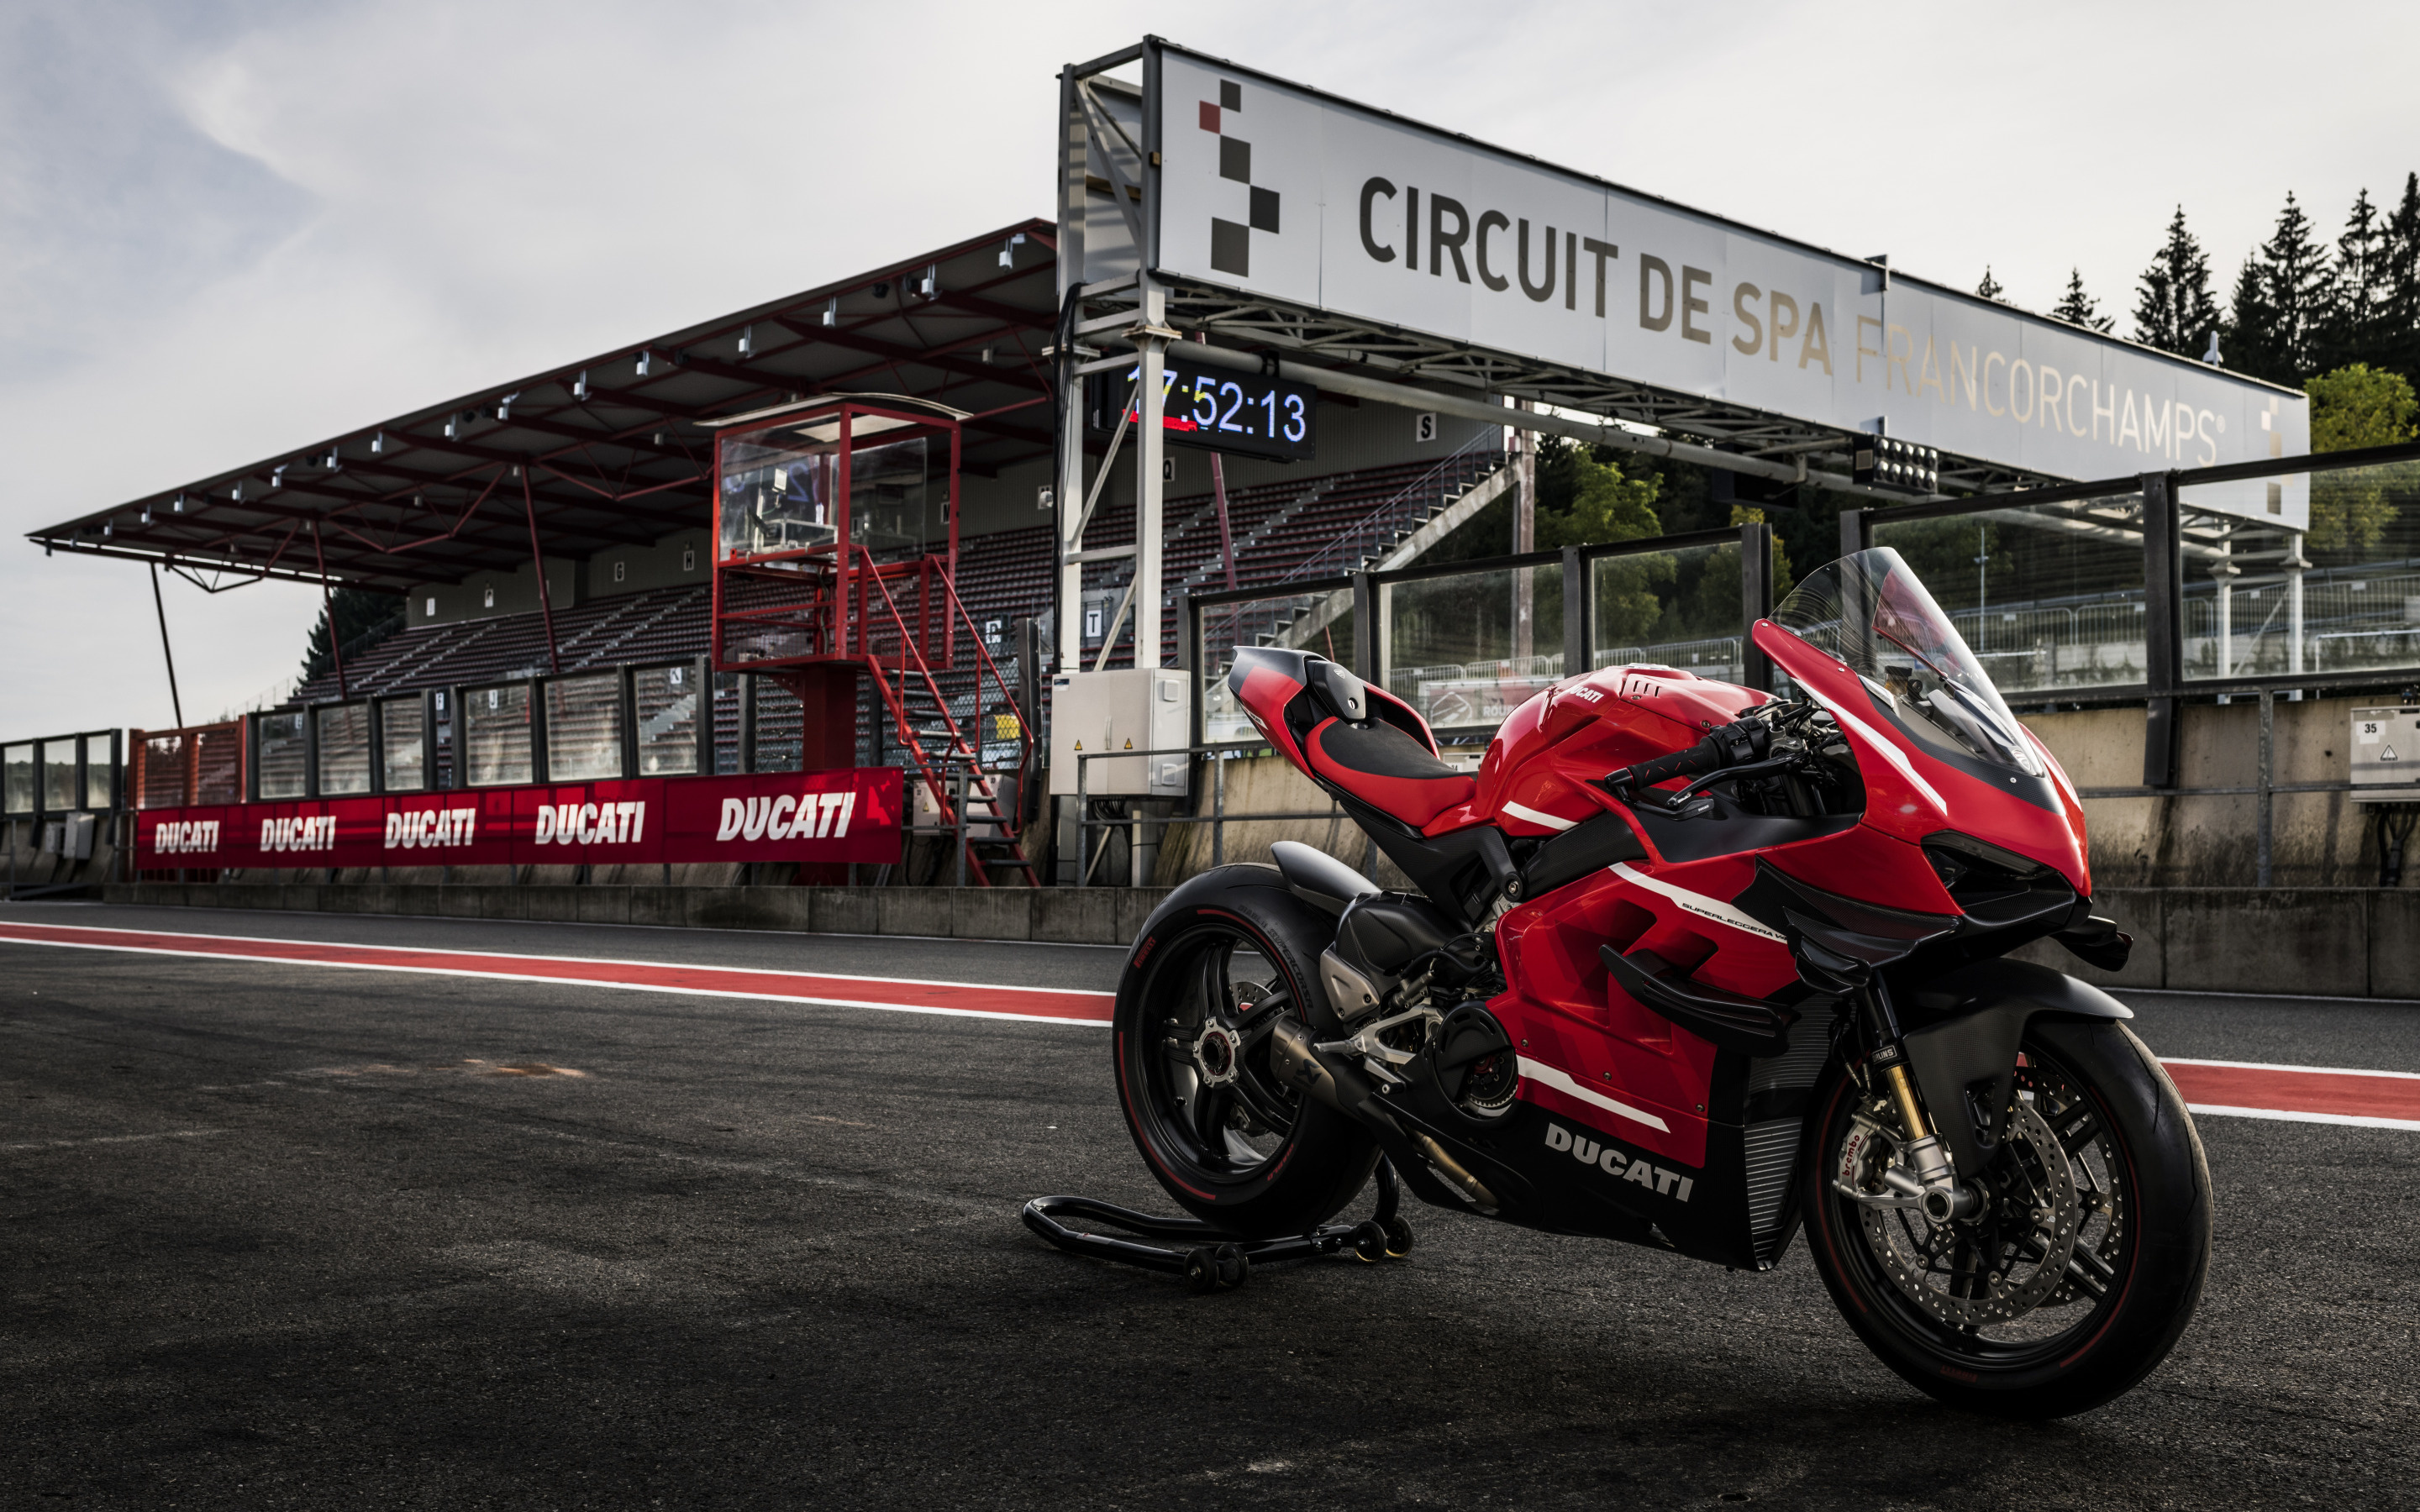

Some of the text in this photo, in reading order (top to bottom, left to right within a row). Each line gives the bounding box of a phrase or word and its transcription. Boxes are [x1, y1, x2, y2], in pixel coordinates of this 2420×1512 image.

[1360, 176, 1618, 318] CIRCUIT
[1639, 252, 1712, 345] DE
[1732, 281, 1833, 377] SPA
[1420, 415, 1432, 439] S
[1163, 459, 1172, 481] Q
[616, 563, 623, 580] G
[686, 552, 692, 569] H
[1088, 613, 1099, 633] T
[2365, 723, 2377, 733] 35
[260, 815, 337, 852] DUCATI
[384, 807, 476, 849] DUCATI
[534, 801, 646, 846] DUCATI
[715, 791, 857, 842] DUCATI
[155, 820, 219, 854] DUCATI
[1681, 902, 1773, 937] SUPERLEGGERA
[1267, 928, 1314, 1009] SUPERCORSA
[1544, 1121, 1695, 1204] DUCATI
[1842, 1134, 1860, 1177] brembo
